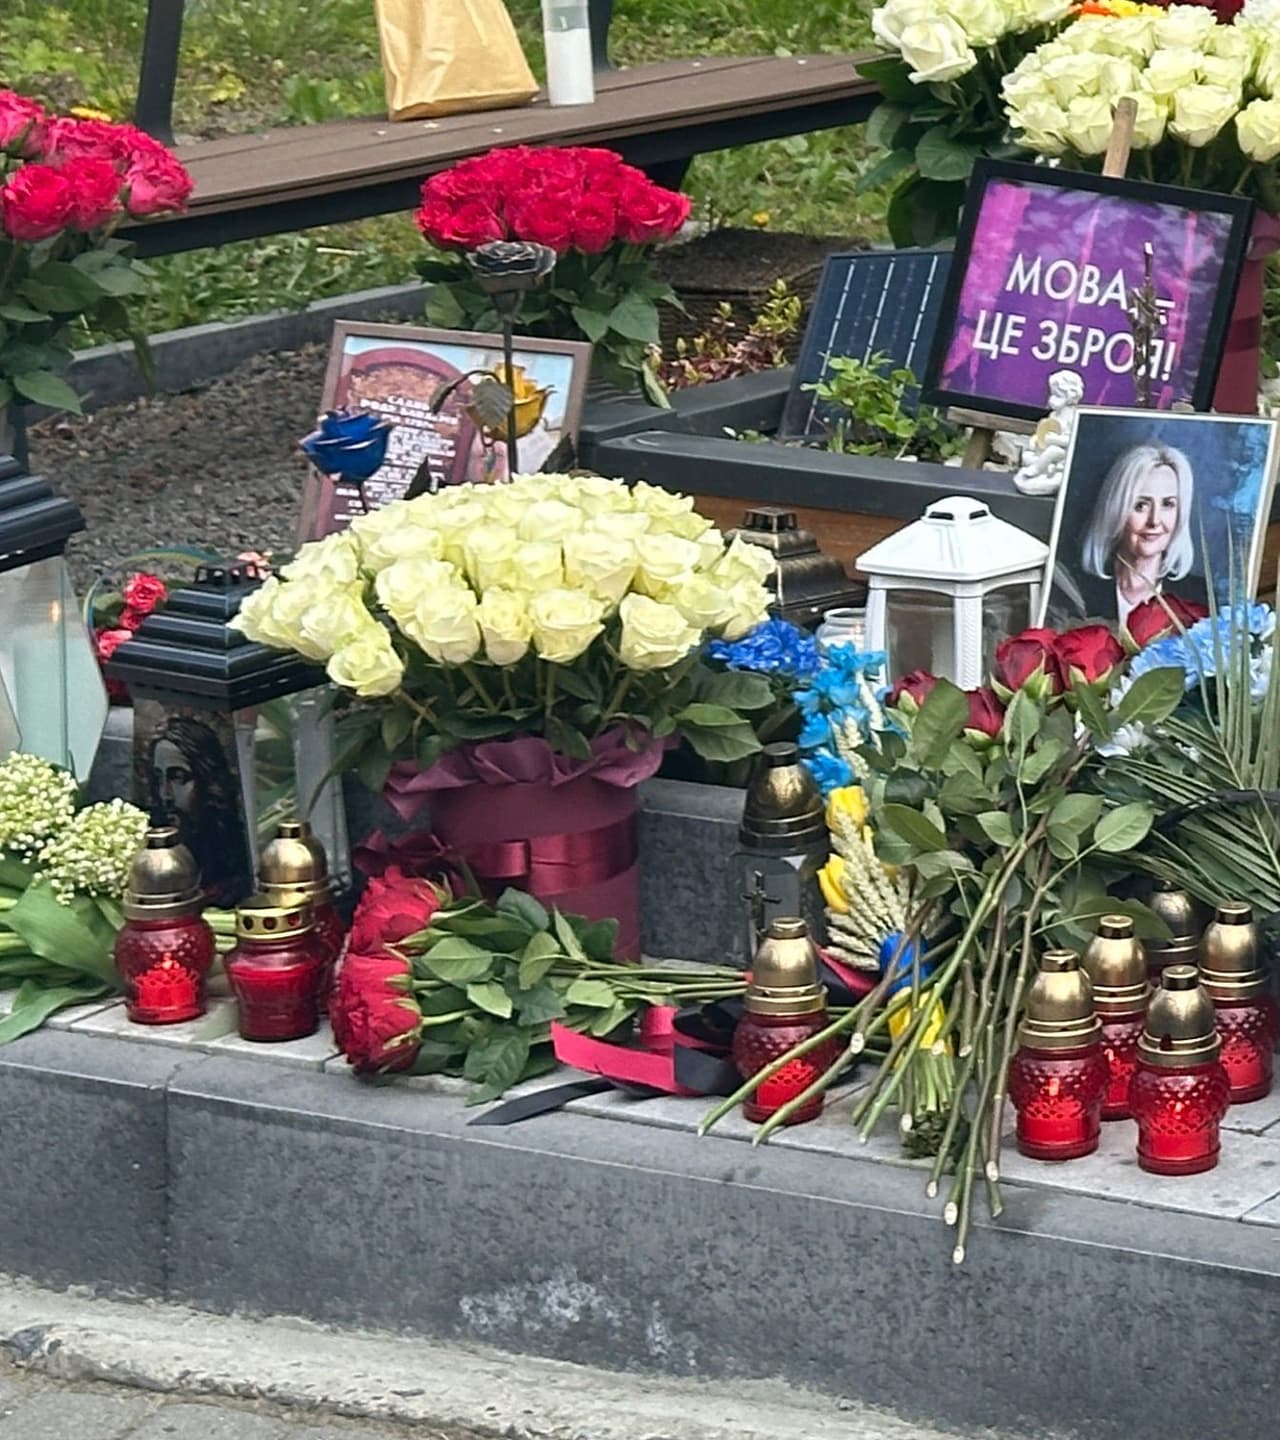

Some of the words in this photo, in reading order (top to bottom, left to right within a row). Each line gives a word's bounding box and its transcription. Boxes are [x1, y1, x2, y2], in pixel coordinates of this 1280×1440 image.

[1005, 252, 1129, 311] МОВА
[972, 309, 1026, 360] ЦЕ
[1031, 319, 1177, 381] ЗБРОЯ!
